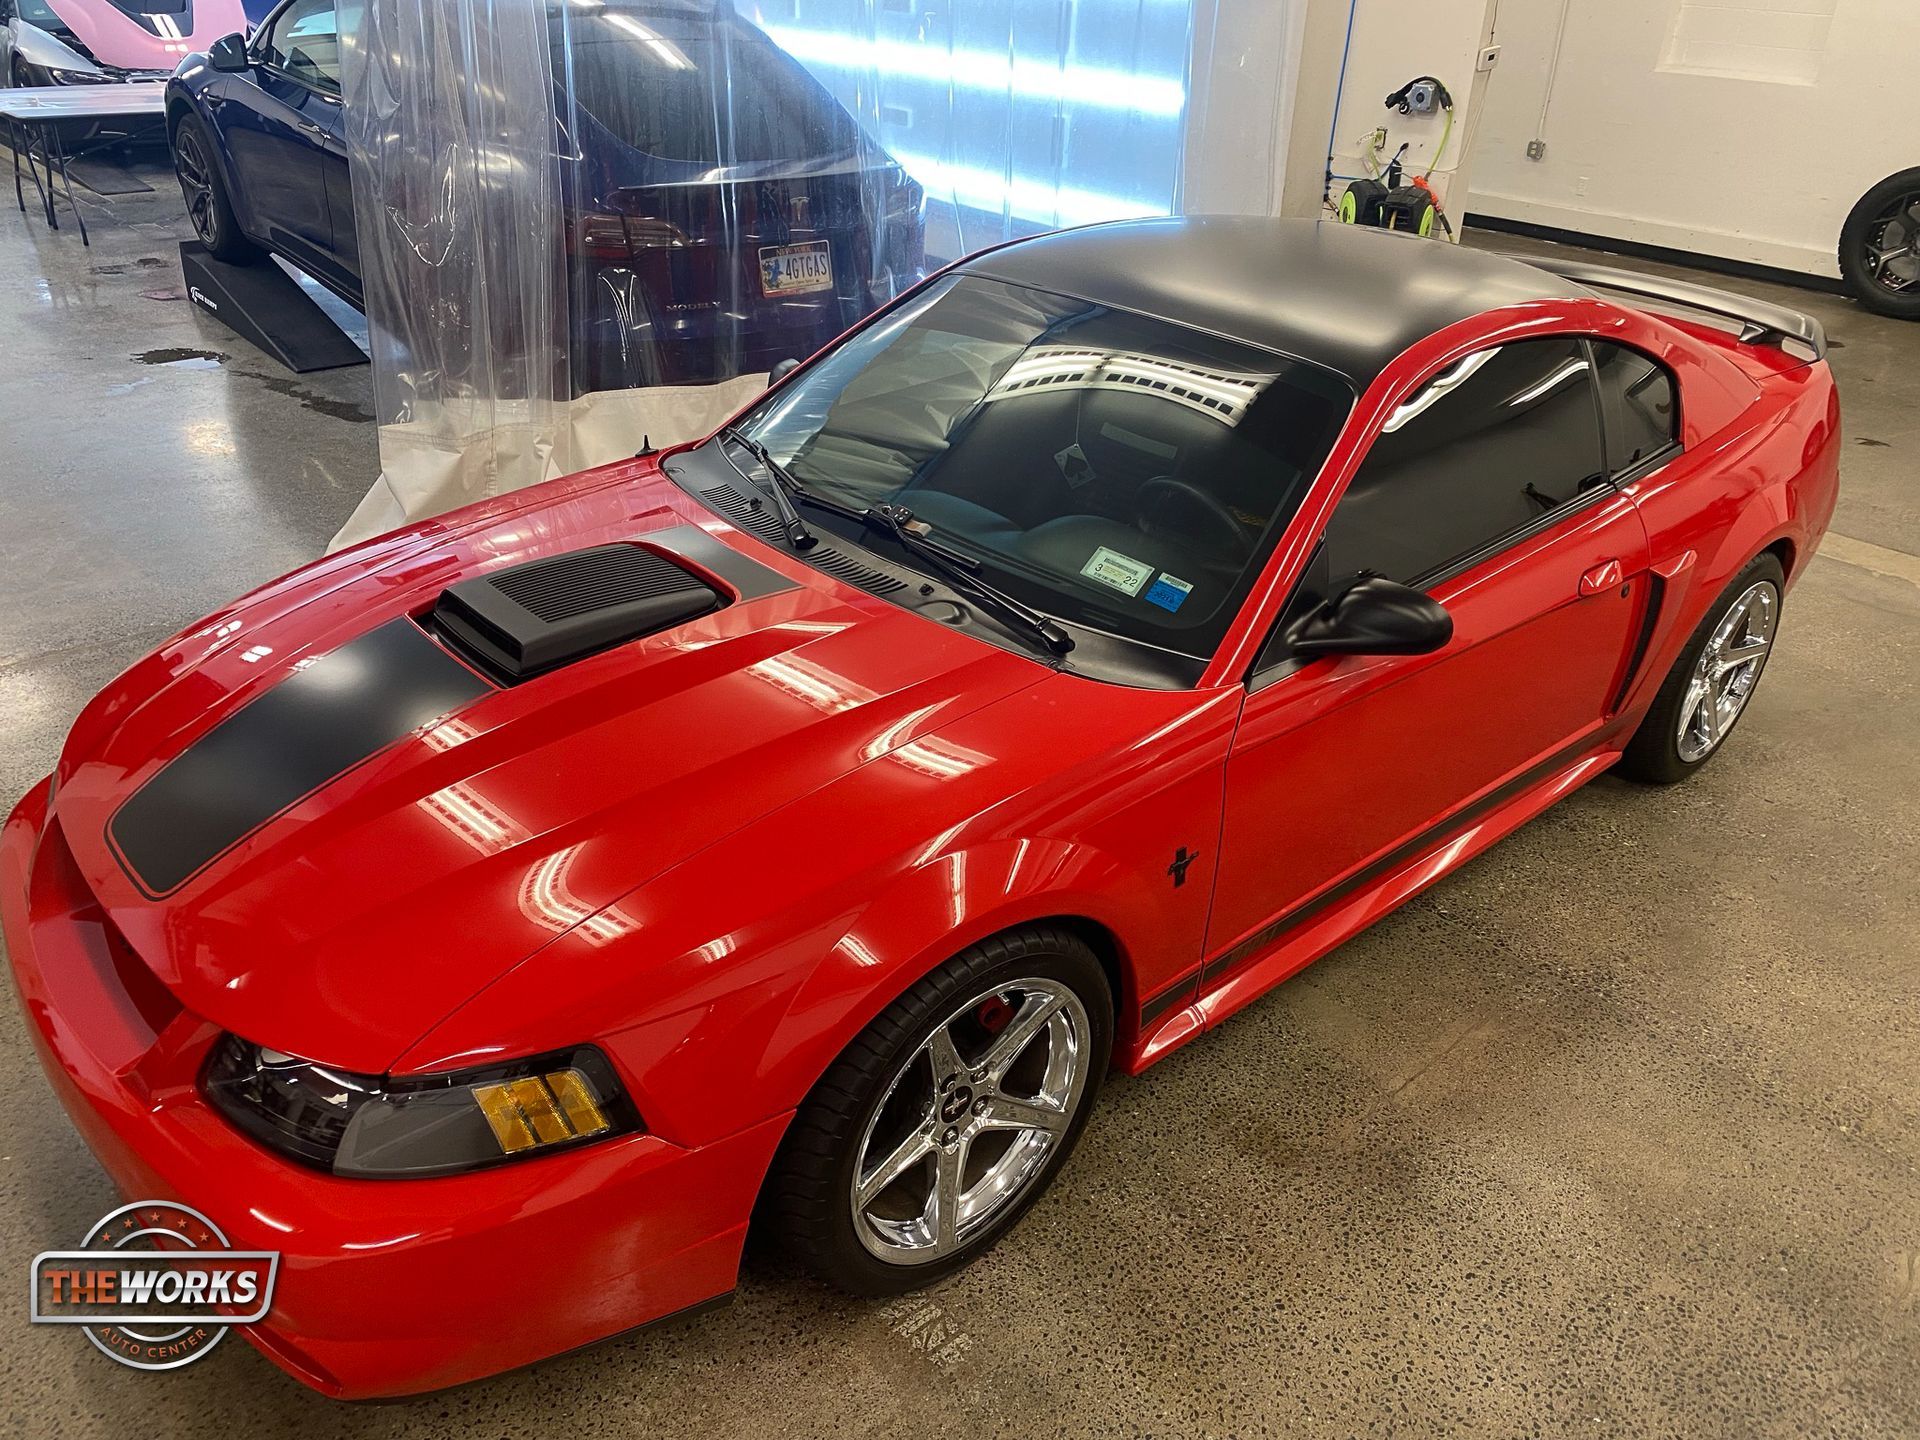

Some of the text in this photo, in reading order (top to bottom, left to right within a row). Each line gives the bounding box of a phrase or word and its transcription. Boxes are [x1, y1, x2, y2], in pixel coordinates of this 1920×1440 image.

[785, 254, 828, 280] 4GTGAS
[1095, 563, 1104, 572] 3
[1123, 575, 1138, 588] 22
